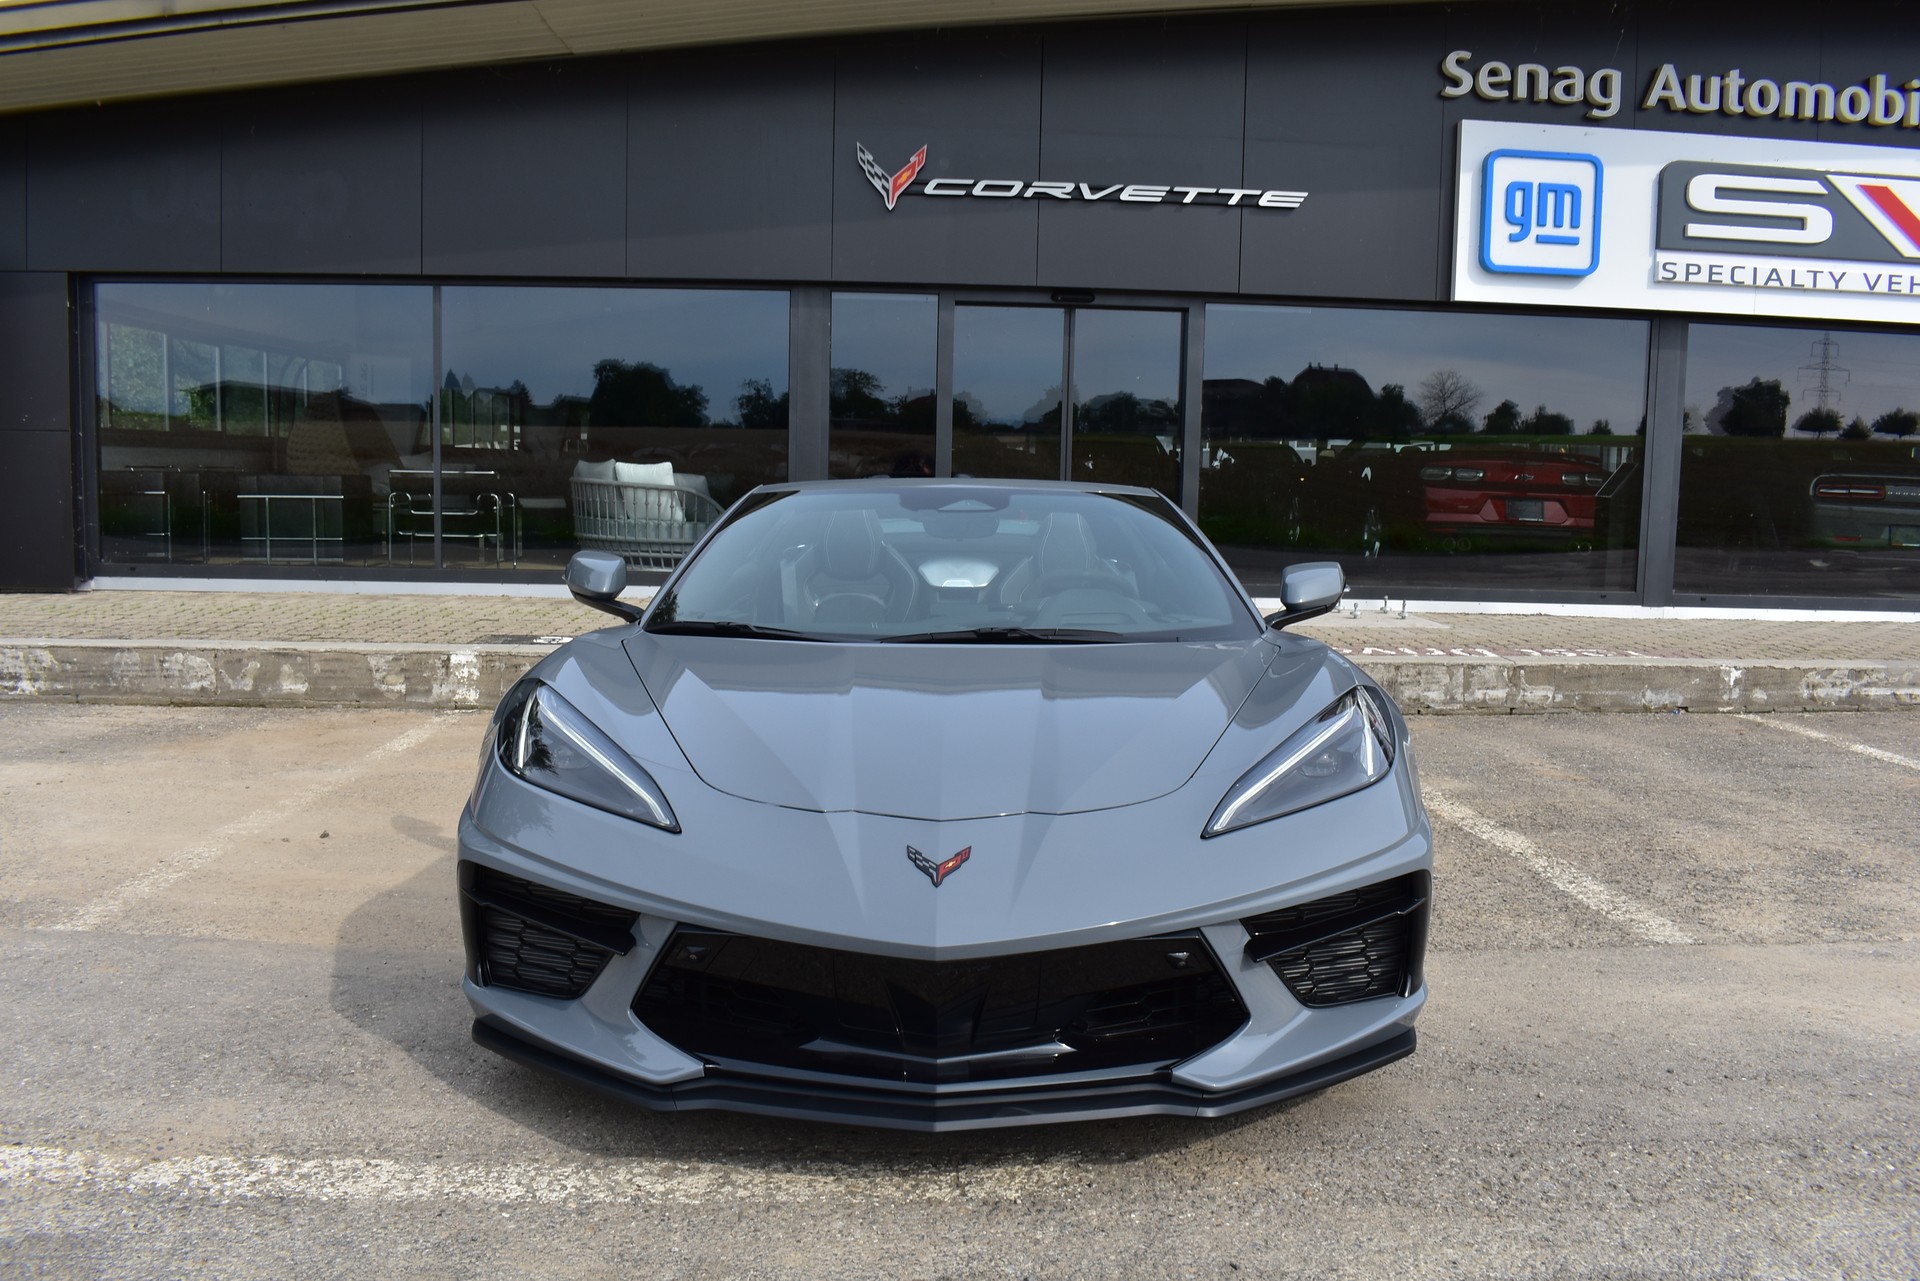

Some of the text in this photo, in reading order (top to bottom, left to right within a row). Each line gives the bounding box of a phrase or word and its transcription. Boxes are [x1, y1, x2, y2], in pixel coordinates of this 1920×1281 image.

[1441, 50, 1622, 119] Senag
[923, 178, 1309, 208] CORVETTE
[1661, 261, 1847, 290] SPECIALTY
